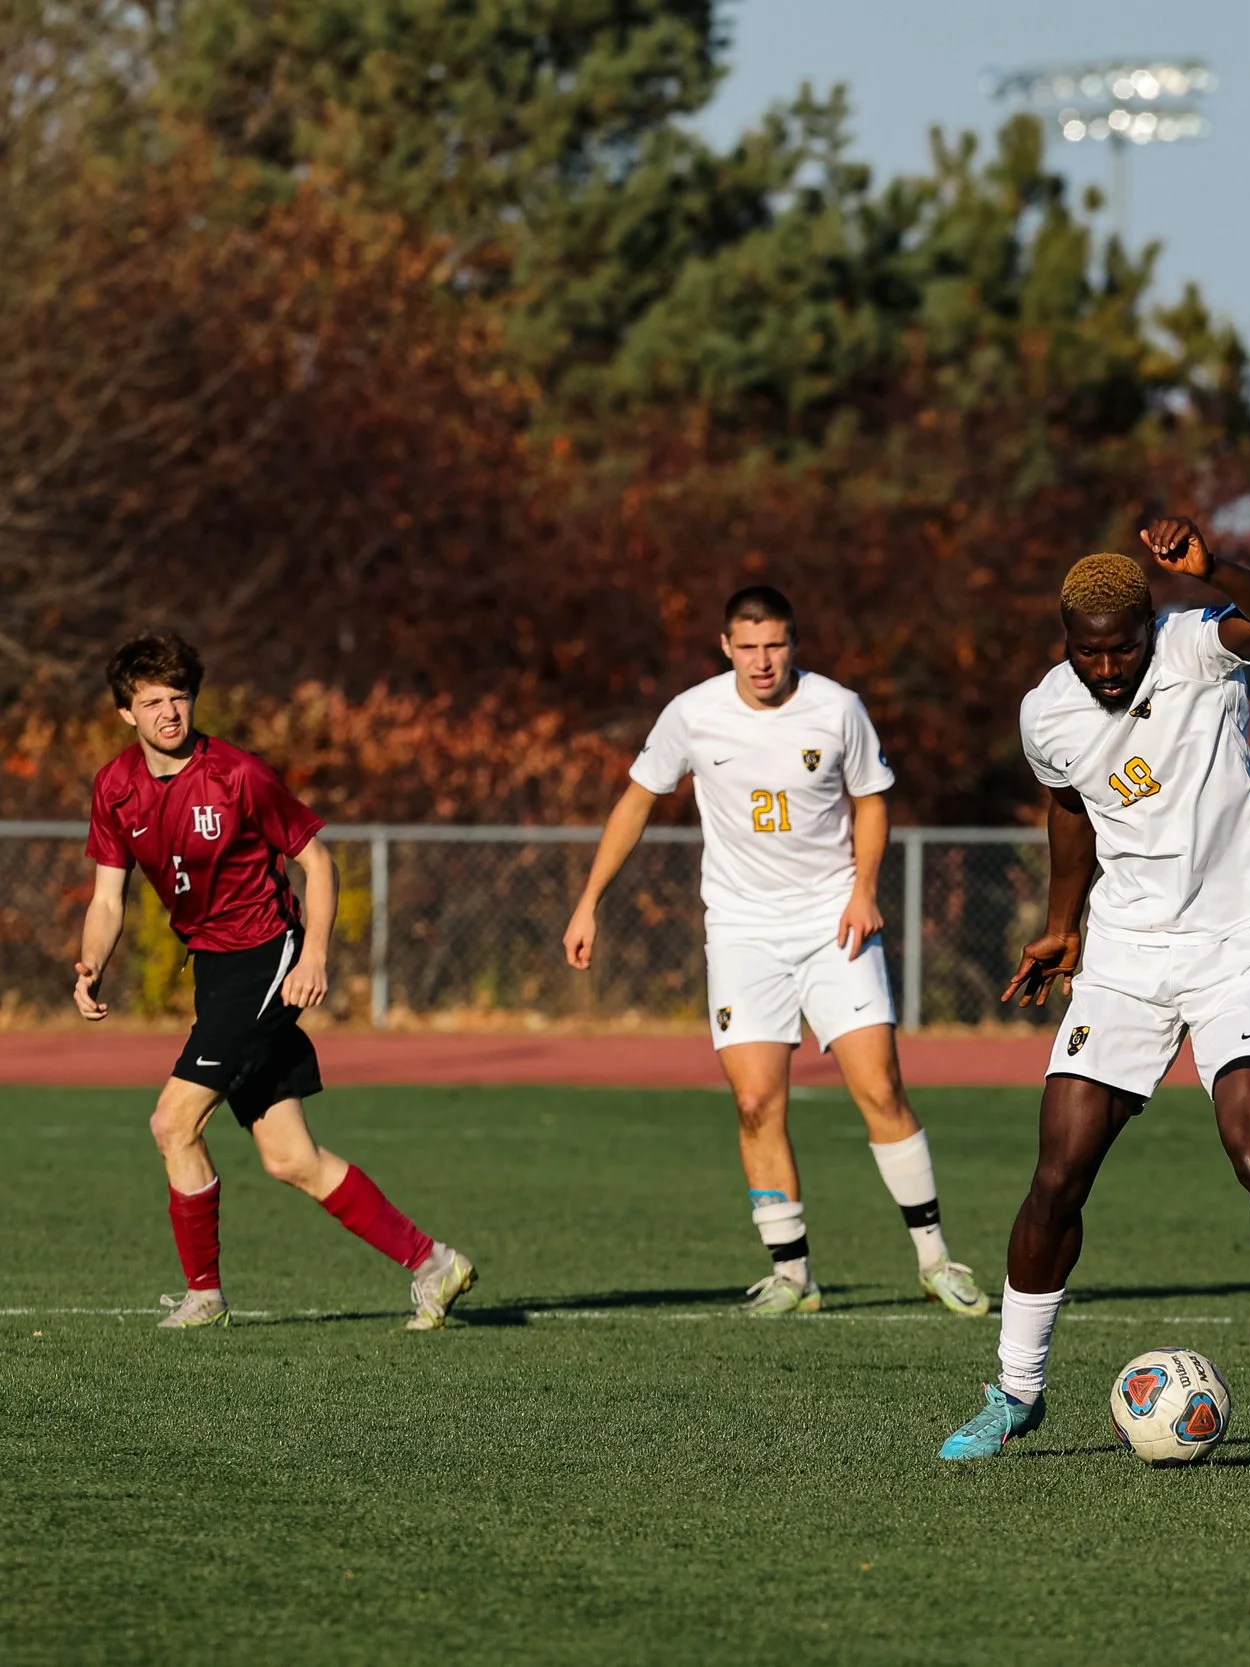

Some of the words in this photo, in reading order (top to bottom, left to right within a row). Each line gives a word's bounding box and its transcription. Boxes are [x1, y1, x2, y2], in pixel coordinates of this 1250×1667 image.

[191, 805, 222, 841] HU
[750, 789, 792, 832] 21
[1170, 1355, 1192, 1389] Wilson
[1188, 1355, 1209, 1383] NCAA
